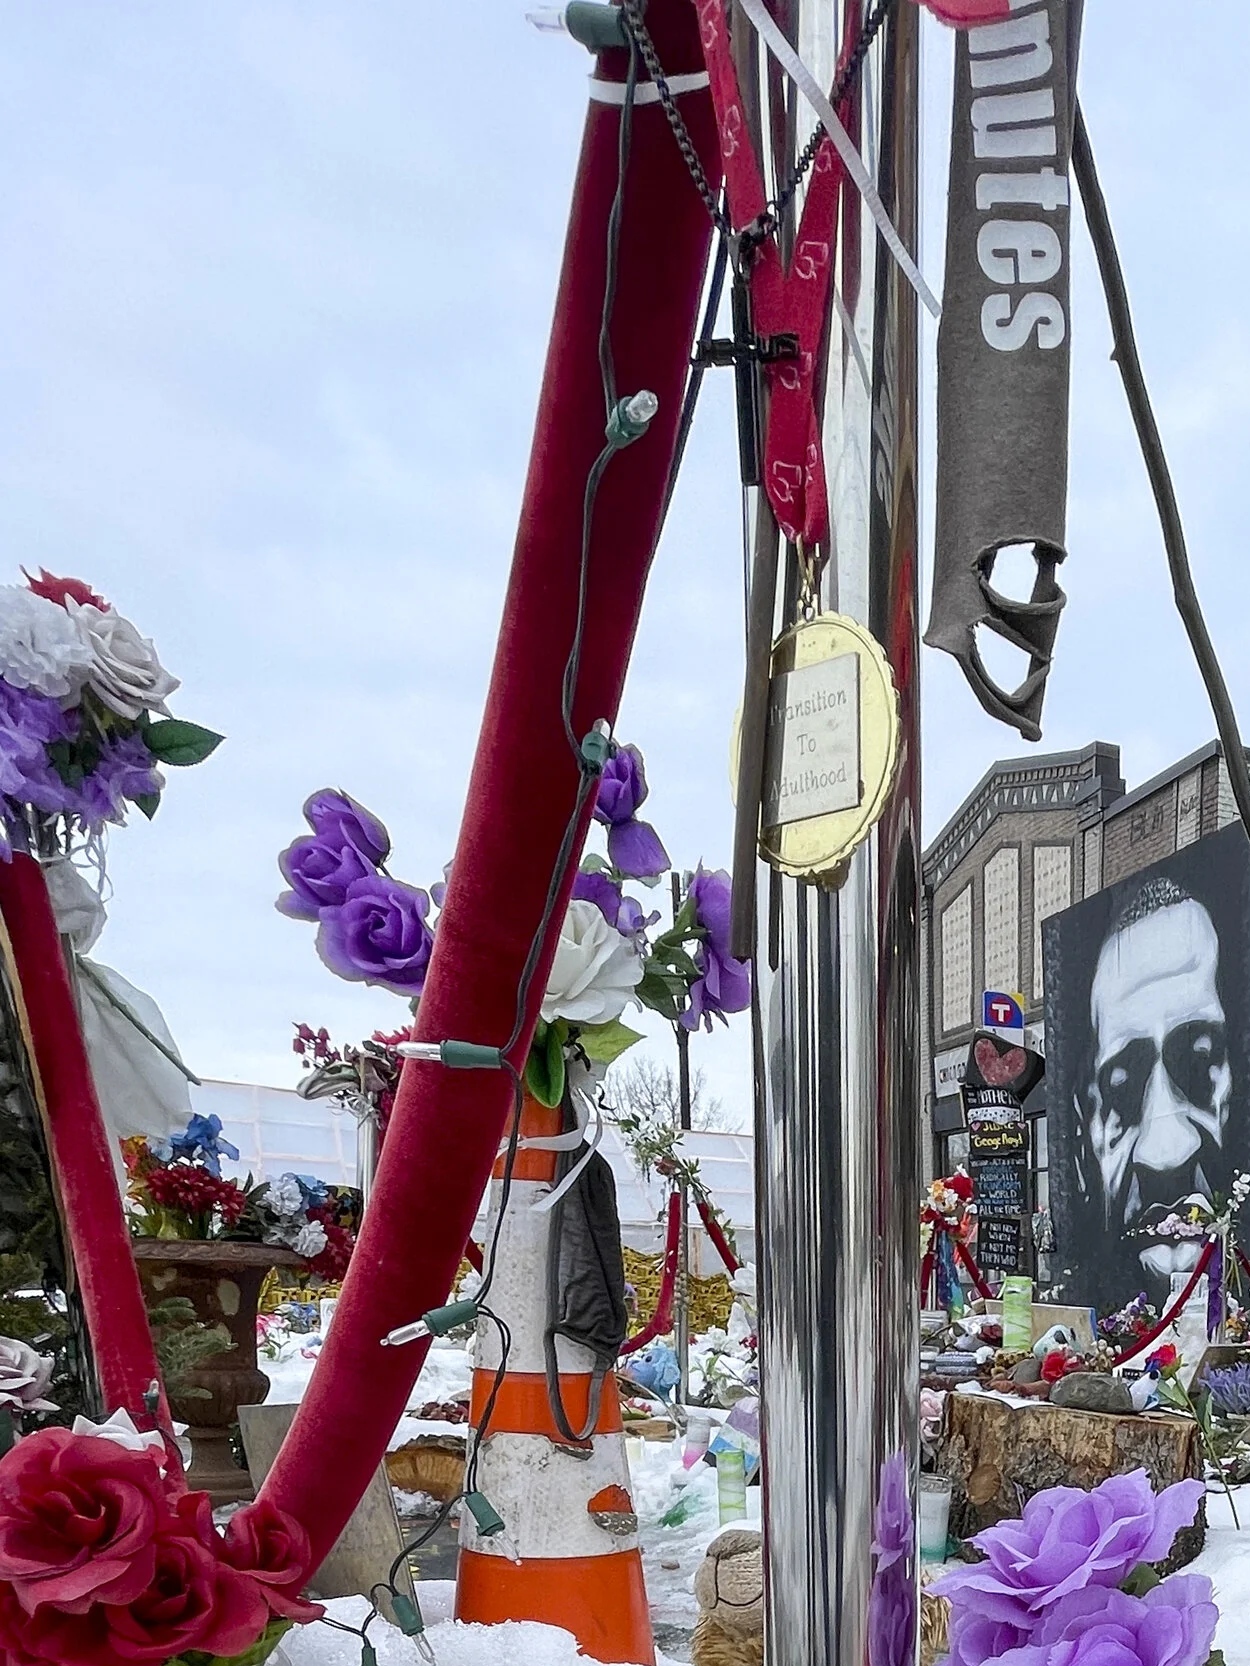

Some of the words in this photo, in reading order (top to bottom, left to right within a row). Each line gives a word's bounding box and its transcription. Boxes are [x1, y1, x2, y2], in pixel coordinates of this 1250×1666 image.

[968, 0, 1065, 352] nutes
[797, 733, 818, 756] To
[991, 1003, 1011, 1022] T
[988, 1189, 1017, 1199] WORLD
